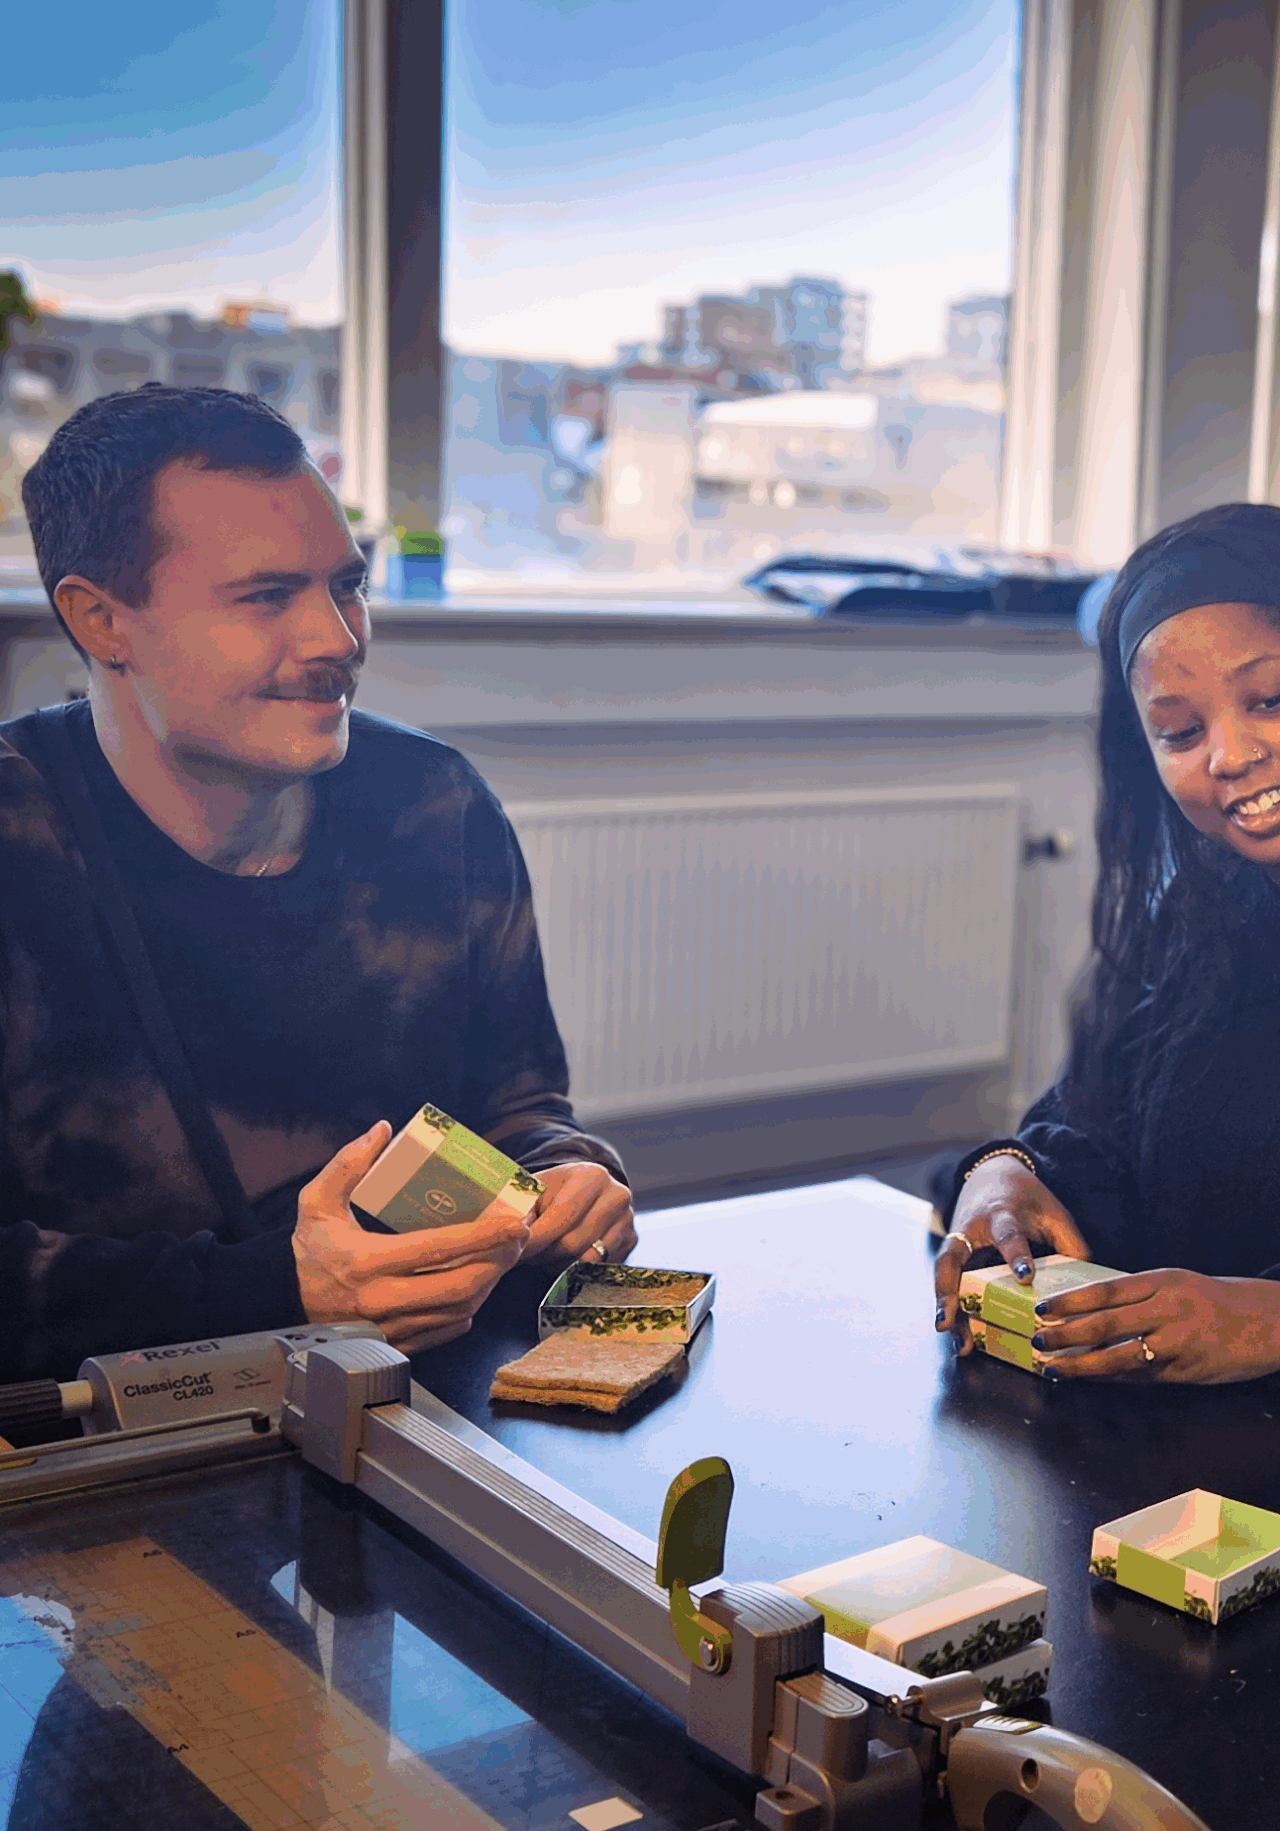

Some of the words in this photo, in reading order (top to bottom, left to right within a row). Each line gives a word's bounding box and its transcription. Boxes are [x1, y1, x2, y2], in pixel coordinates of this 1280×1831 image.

[143, 1341, 221, 1361] Rexel
[123, 1372, 212, 1397] ClassicCut
[173, 1385, 214, 1400] CL420
